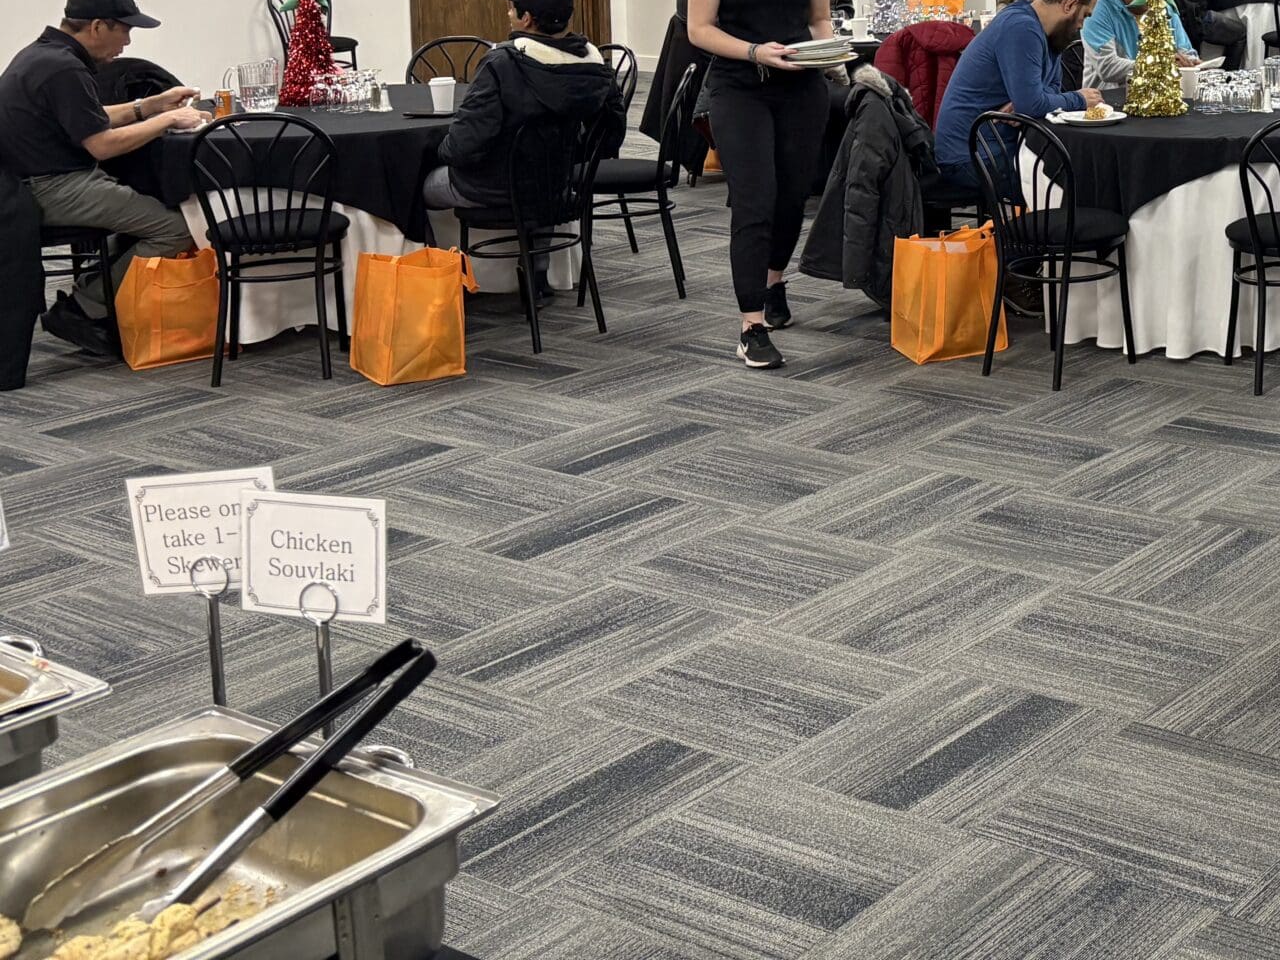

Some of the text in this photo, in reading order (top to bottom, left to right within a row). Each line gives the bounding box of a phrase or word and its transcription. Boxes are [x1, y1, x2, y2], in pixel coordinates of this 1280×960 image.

[144, 502, 241, 522] Please on
[162, 525, 241, 549] take 1-
[270, 529, 353, 554] Chicken
[168, 555, 241, 575] Skewer
[268, 557, 355, 582] Souvlaki
